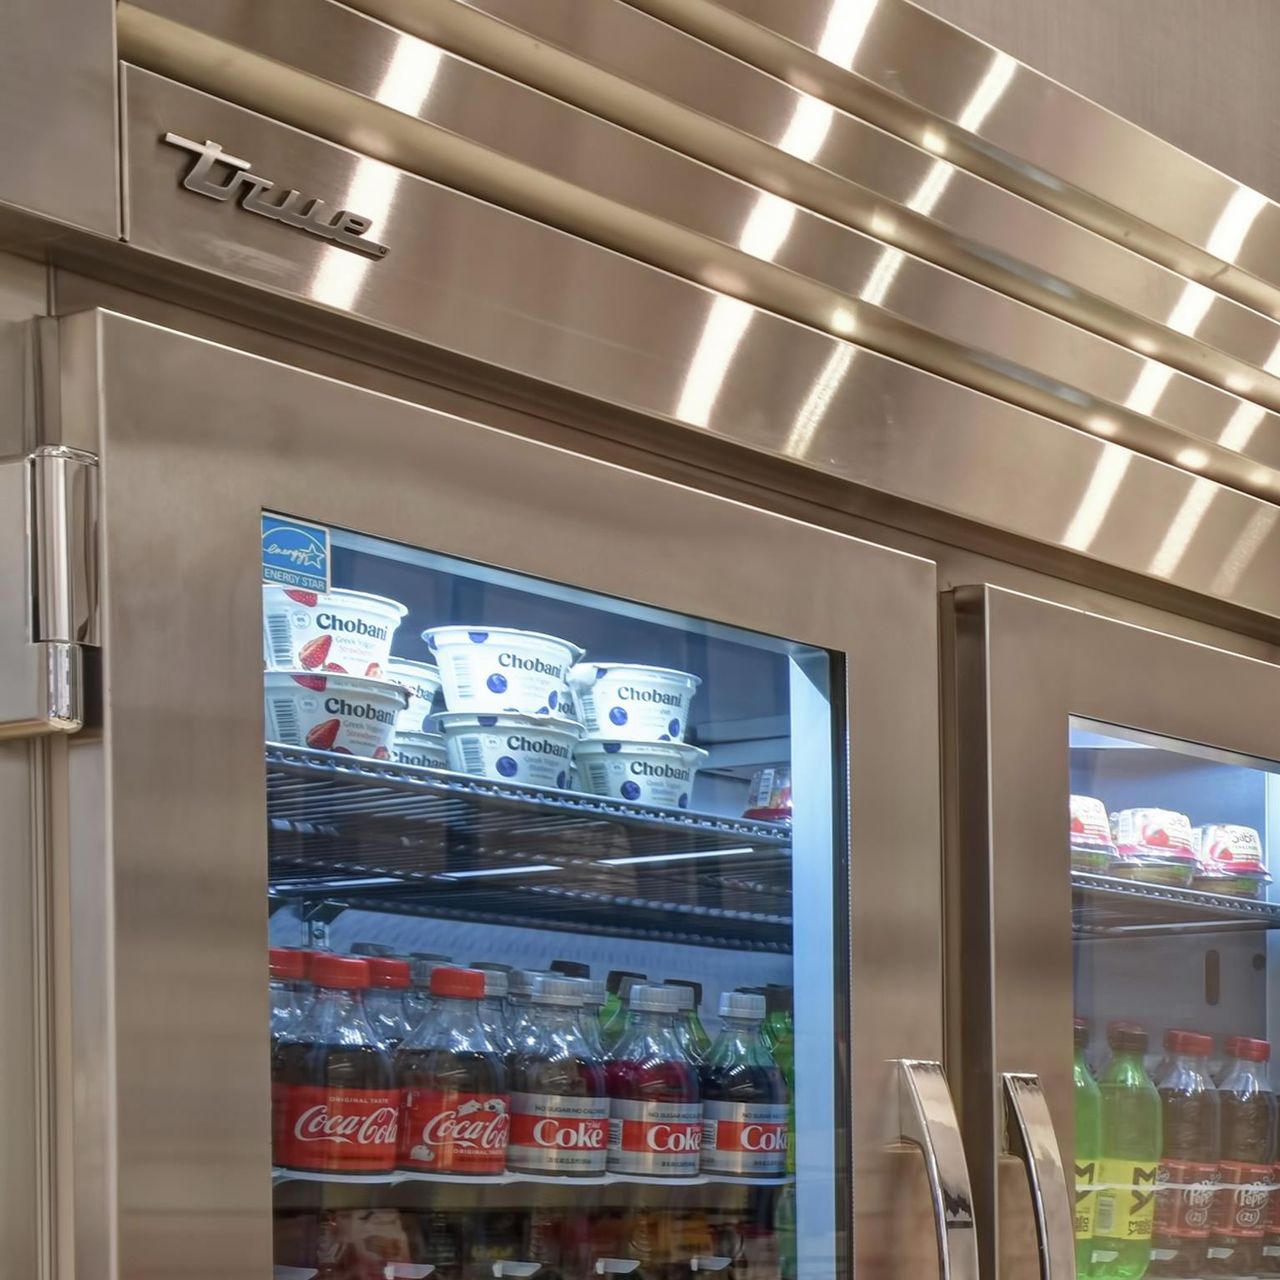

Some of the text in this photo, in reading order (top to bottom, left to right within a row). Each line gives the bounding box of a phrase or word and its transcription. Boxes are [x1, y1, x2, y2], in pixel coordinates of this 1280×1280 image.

[264, 568, 325, 590] ENERGY STAR
[316, 613, 388, 641] Chobani
[498, 653, 562, 679] Chobani
[618, 686, 682, 706] Chobani
[325, 697, 396, 726] Chobani
[507, 735, 570, 758] Chobani
[630, 761, 691, 781] Chobani
[533, 1119, 603, 1148] Coke
